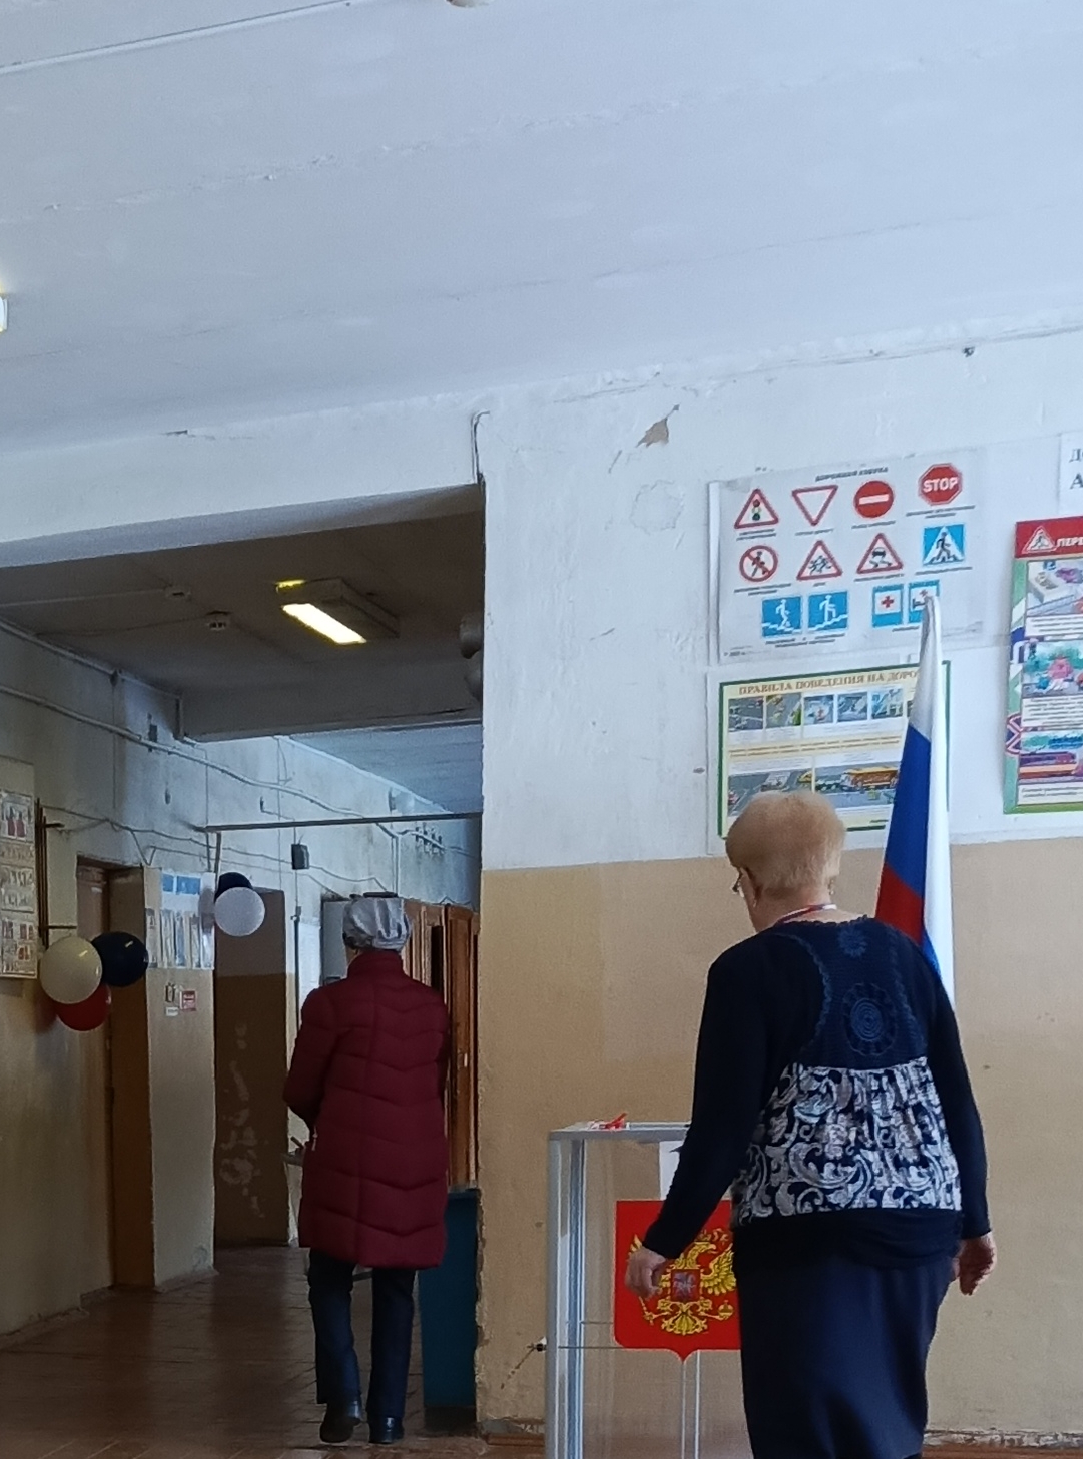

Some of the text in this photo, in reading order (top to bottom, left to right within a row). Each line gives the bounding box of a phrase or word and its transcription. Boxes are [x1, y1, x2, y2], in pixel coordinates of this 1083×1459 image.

[923, 476, 959, 493] STOP
[738, 681, 793, 696] ПРАВИЛА
[795, 674, 864, 690] ПОВЕДЕНИЯ
[867, 672, 885, 683] НА
